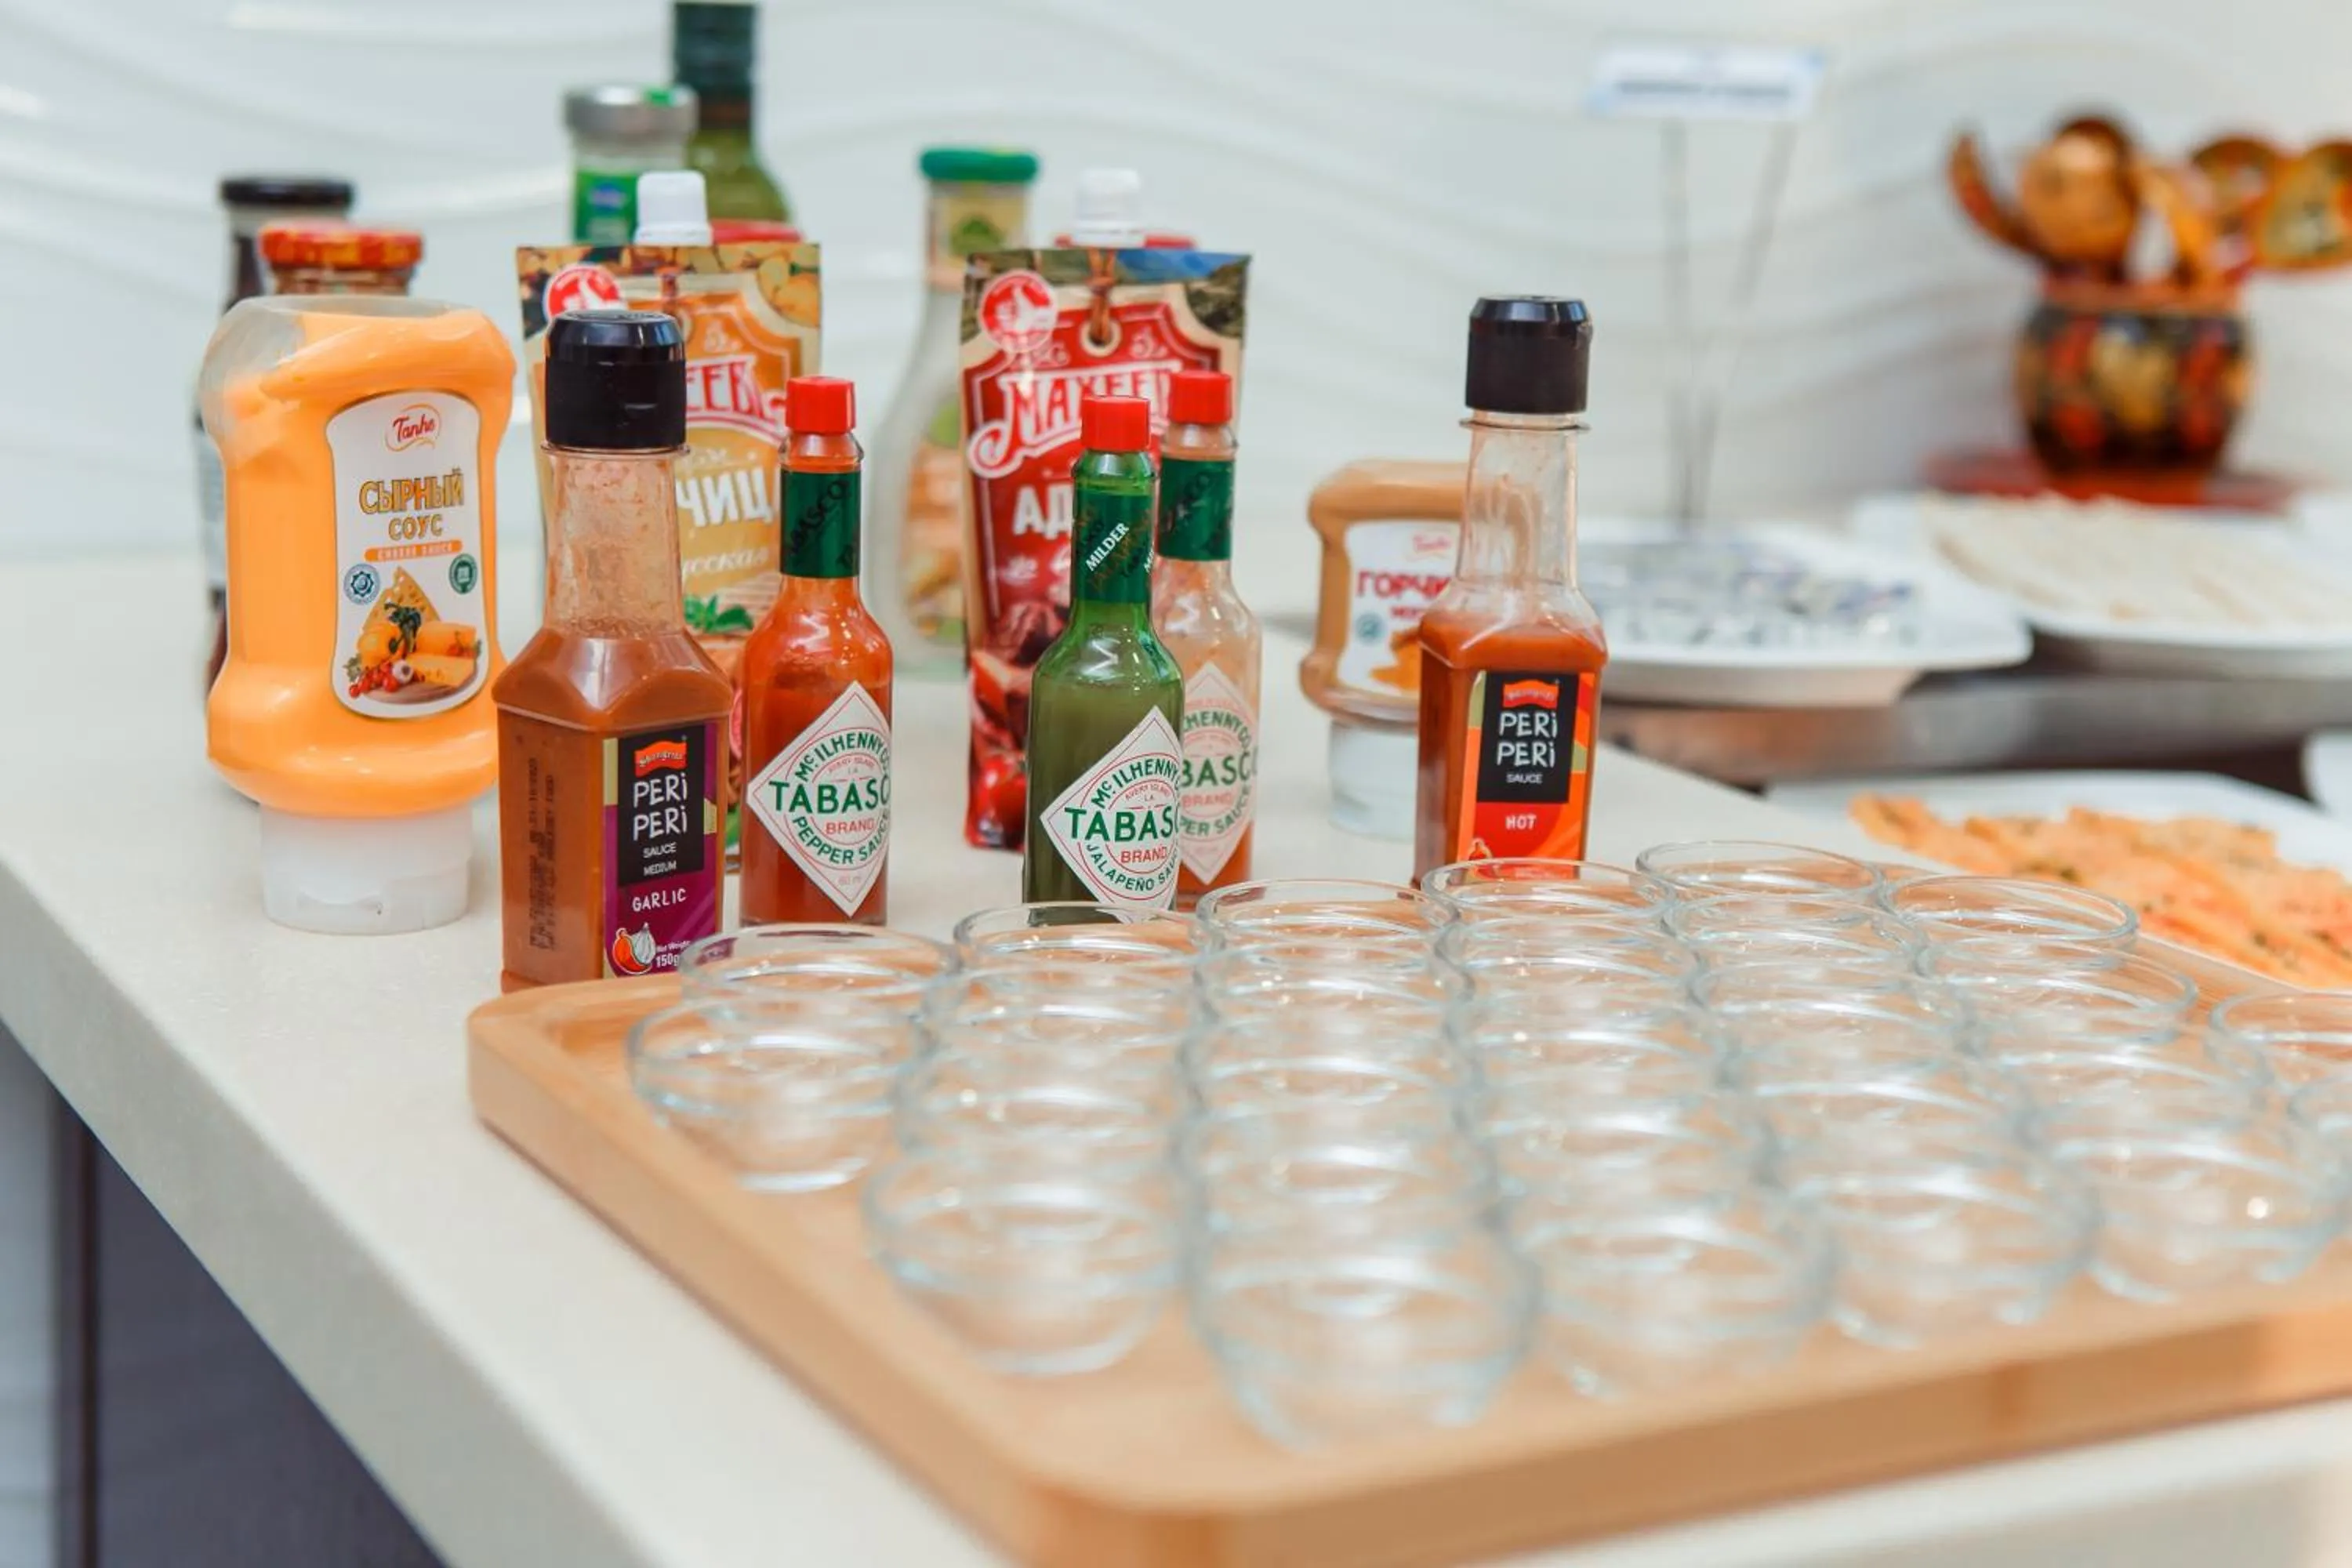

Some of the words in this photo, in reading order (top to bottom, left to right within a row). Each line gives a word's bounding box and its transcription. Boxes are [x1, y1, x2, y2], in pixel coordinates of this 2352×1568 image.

[359, 469, 464, 514] СЫРНЫЙ
[675, 466, 774, 527] ЧИЦ
[388, 514, 444, 541] СОУС
[1085, 522, 1130, 572] MILDER
[1506, 773, 1542, 785] SAUCE
[826, 818, 876, 836] BRAND
[1064, 806, 1179, 842] TABAS
[1505, 815, 1537, 831] HOT
[643, 842, 677, 858] SAUCE
[1120, 844, 1168, 864] BRAND
[632, 887, 687, 913] GARLIC
